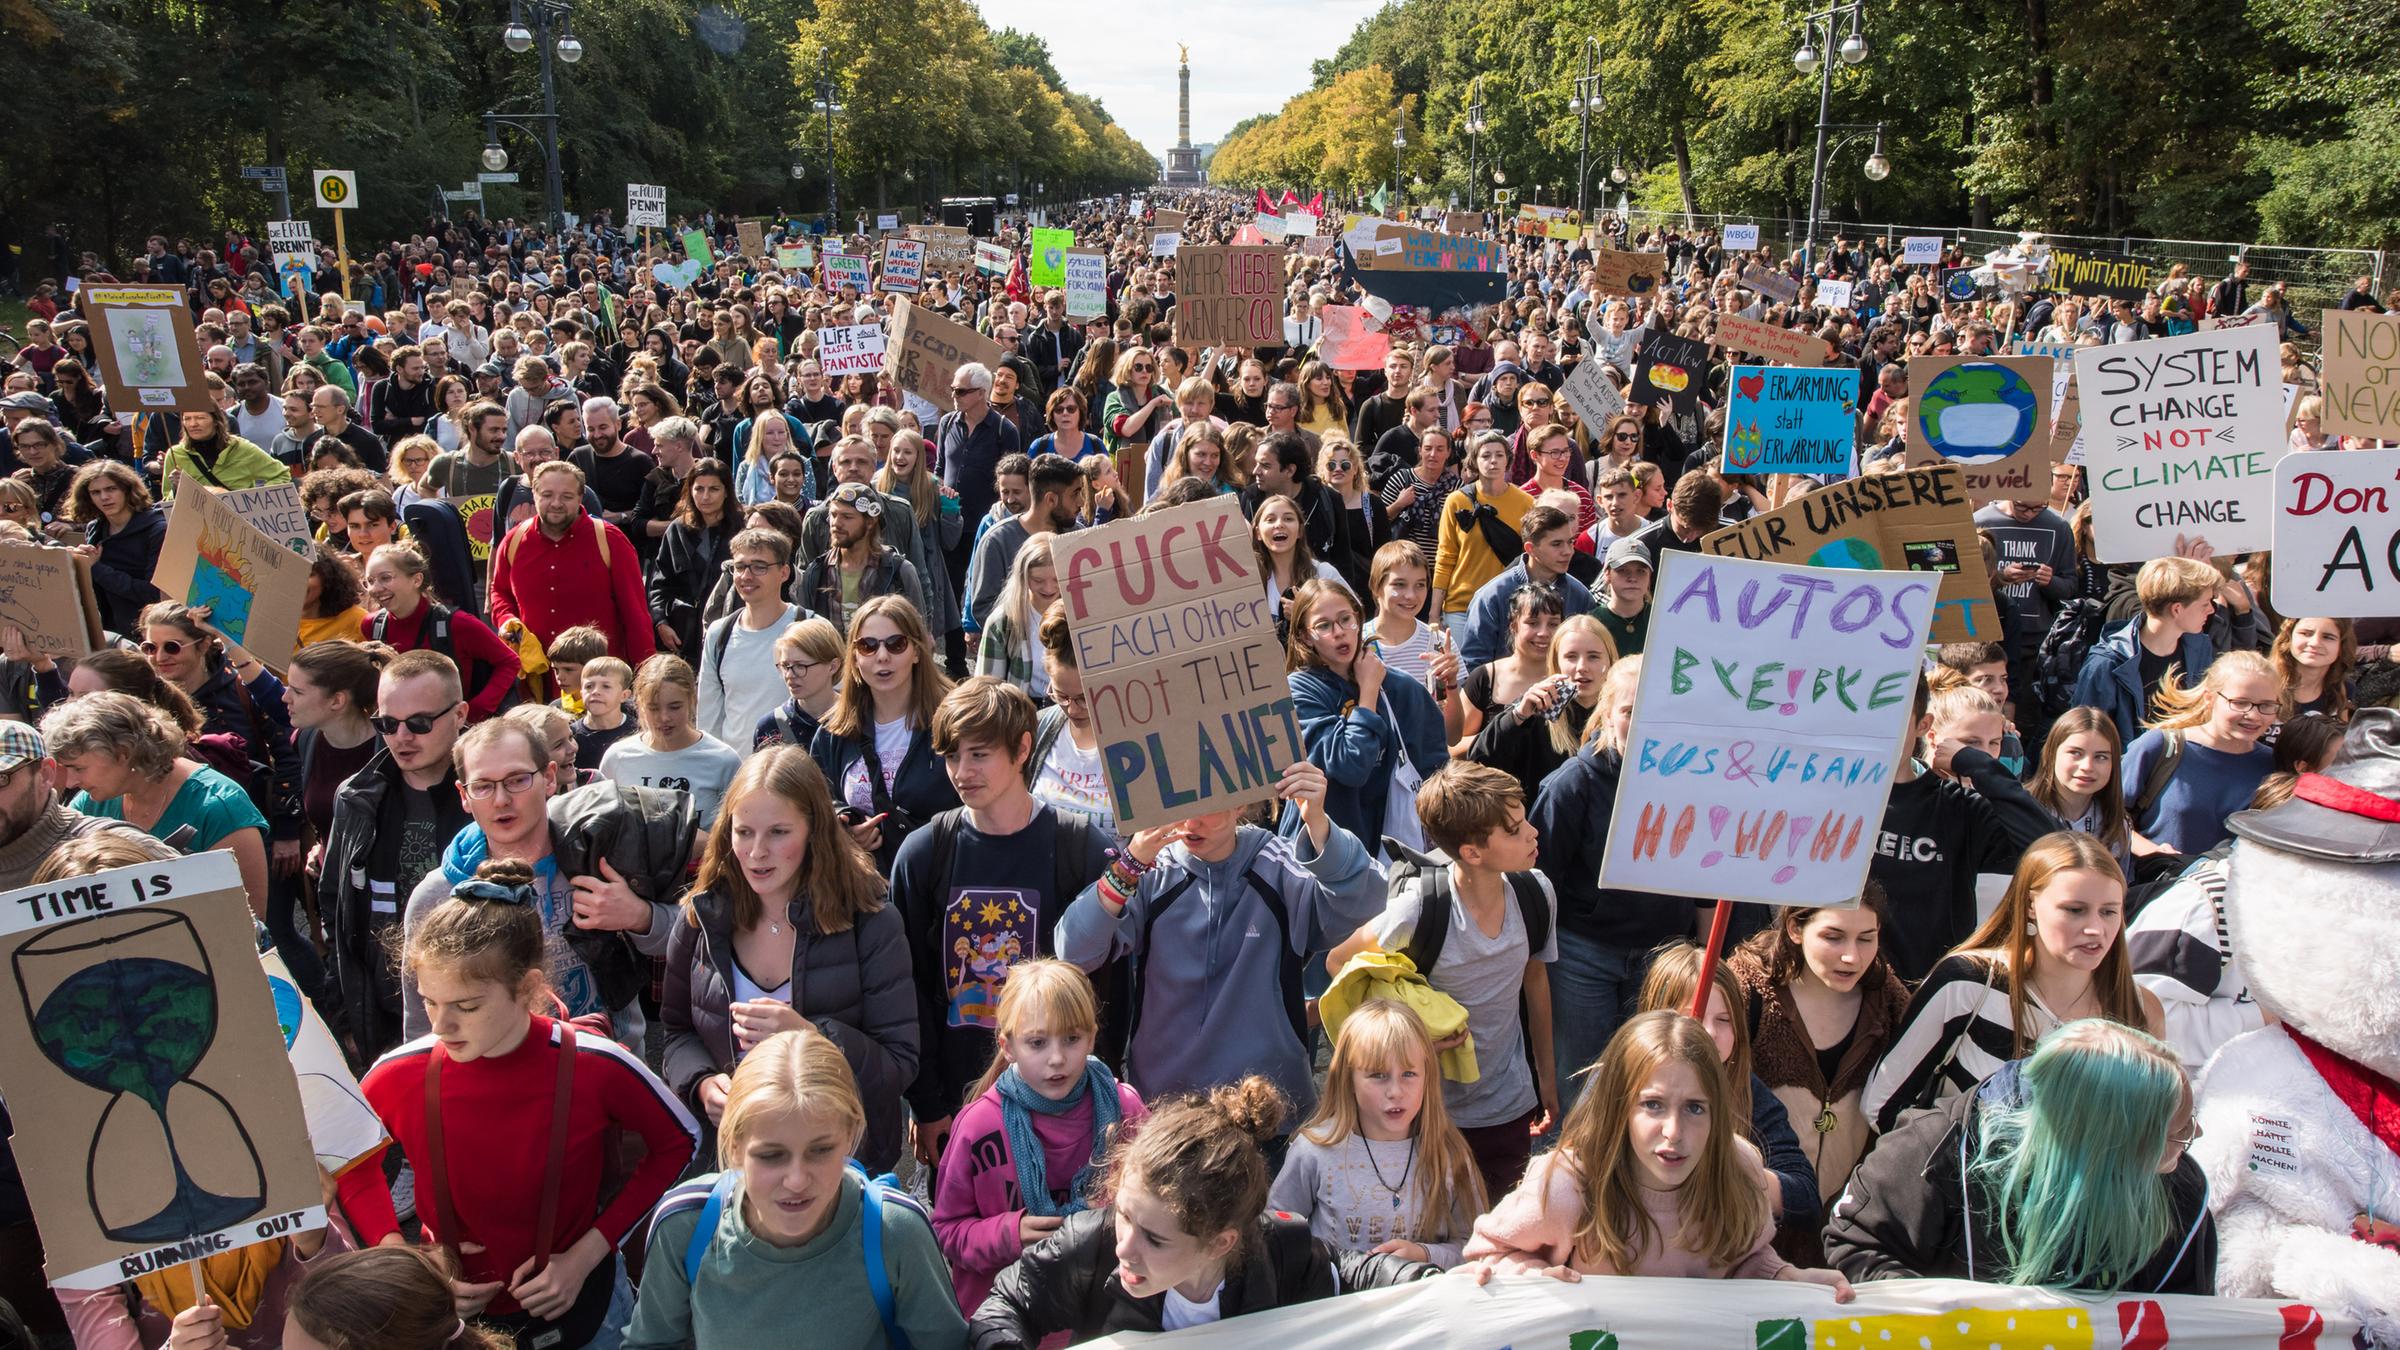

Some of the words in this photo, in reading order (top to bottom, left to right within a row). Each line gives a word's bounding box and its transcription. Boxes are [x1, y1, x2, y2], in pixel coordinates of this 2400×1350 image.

[327, 182, 340, 197] H
[639, 185, 666, 199] POLITIK
[270, 230, 281, 238] DIE
[281, 222, 311, 238] ERDE
[1407, 231, 1432, 248] WIR
[1726, 229, 1756, 240] WBGU
[271, 241, 312, 254] BRENNT
[897, 242, 917, 250] WHY
[906, 252, 919, 260] WE
[1907, 241, 1939, 253] WBGU
[830, 257, 861, 269] GREEN
[887, 260, 921, 268] WAITING?
[1404, 249, 1452, 269] KEINEN
[829, 270, 849, 281] NEW
[850, 273, 868, 282] DEAL
[901, 268, 917, 276] ARE
[1067, 270, 1102, 279] FORSCHER
[1180, 253, 1225, 295] MEHR
[1229, 253, 1277, 295] LIEBE
[2074, 256, 2153, 289] INITIATIVE
[1180, 299, 1246, 342] WENIGER
[823, 328, 852, 346] LIFE
[823, 344, 853, 354] PLASTIC
[858, 340, 865, 350] is
[1722, 330, 1738, 341] not
[1743, 334, 1757, 347] the
[1760, 336, 1800, 358] climate
[2338, 317, 2400, 361] NO
[823, 352, 885, 372] FANTASTIC
[2021, 343, 2073, 360] MAKE
[2098, 348, 2261, 396] SYSTEM
[2366, 365, 2400, 385] or
[1770, 372, 1850, 403] ERWÄRMUNG
[1774, 408, 1804, 429] statt
[2110, 394, 2238, 427] CHANGE
[1763, 436, 1845, 465] ERWÄRMUNG
[2143, 428, 2213, 451] NOT
[1965, 474, 1991, 489] zu
[1996, 464, 2033, 489] viel
[2102, 451, 2272, 492] CLIMATE
[191, 489, 207, 514] OUR
[221, 487, 301, 514] CLIMATE
[1803, 468, 1965, 535] UNSERE
[246, 510, 305, 536] ANGE
[2135, 500, 2246, 529] CHANGE
[2003, 540, 2037, 558] THANK
[1667, 565, 1930, 650] AUTOS
[1076, 612, 1176, 670] EACH
[1182, 598, 1267, 643] Other
[1088, 669, 1171, 734] not
[1181, 644, 1272, 705] THE
[1103, 696, 1307, 822] PLANET
[1638, 737, 1721, 778] BUS
[1723, 740, 1760, 788] &
[1766, 746, 1889, 789] U-BAHN
[17, 882, 113, 922] TIME
[131, 874, 174, 903] IS
[2251, 1153, 2297, 1173] MACHEN!
[119, 1234, 235, 1281] RUNNING
[256, 1211, 306, 1239] OUT
